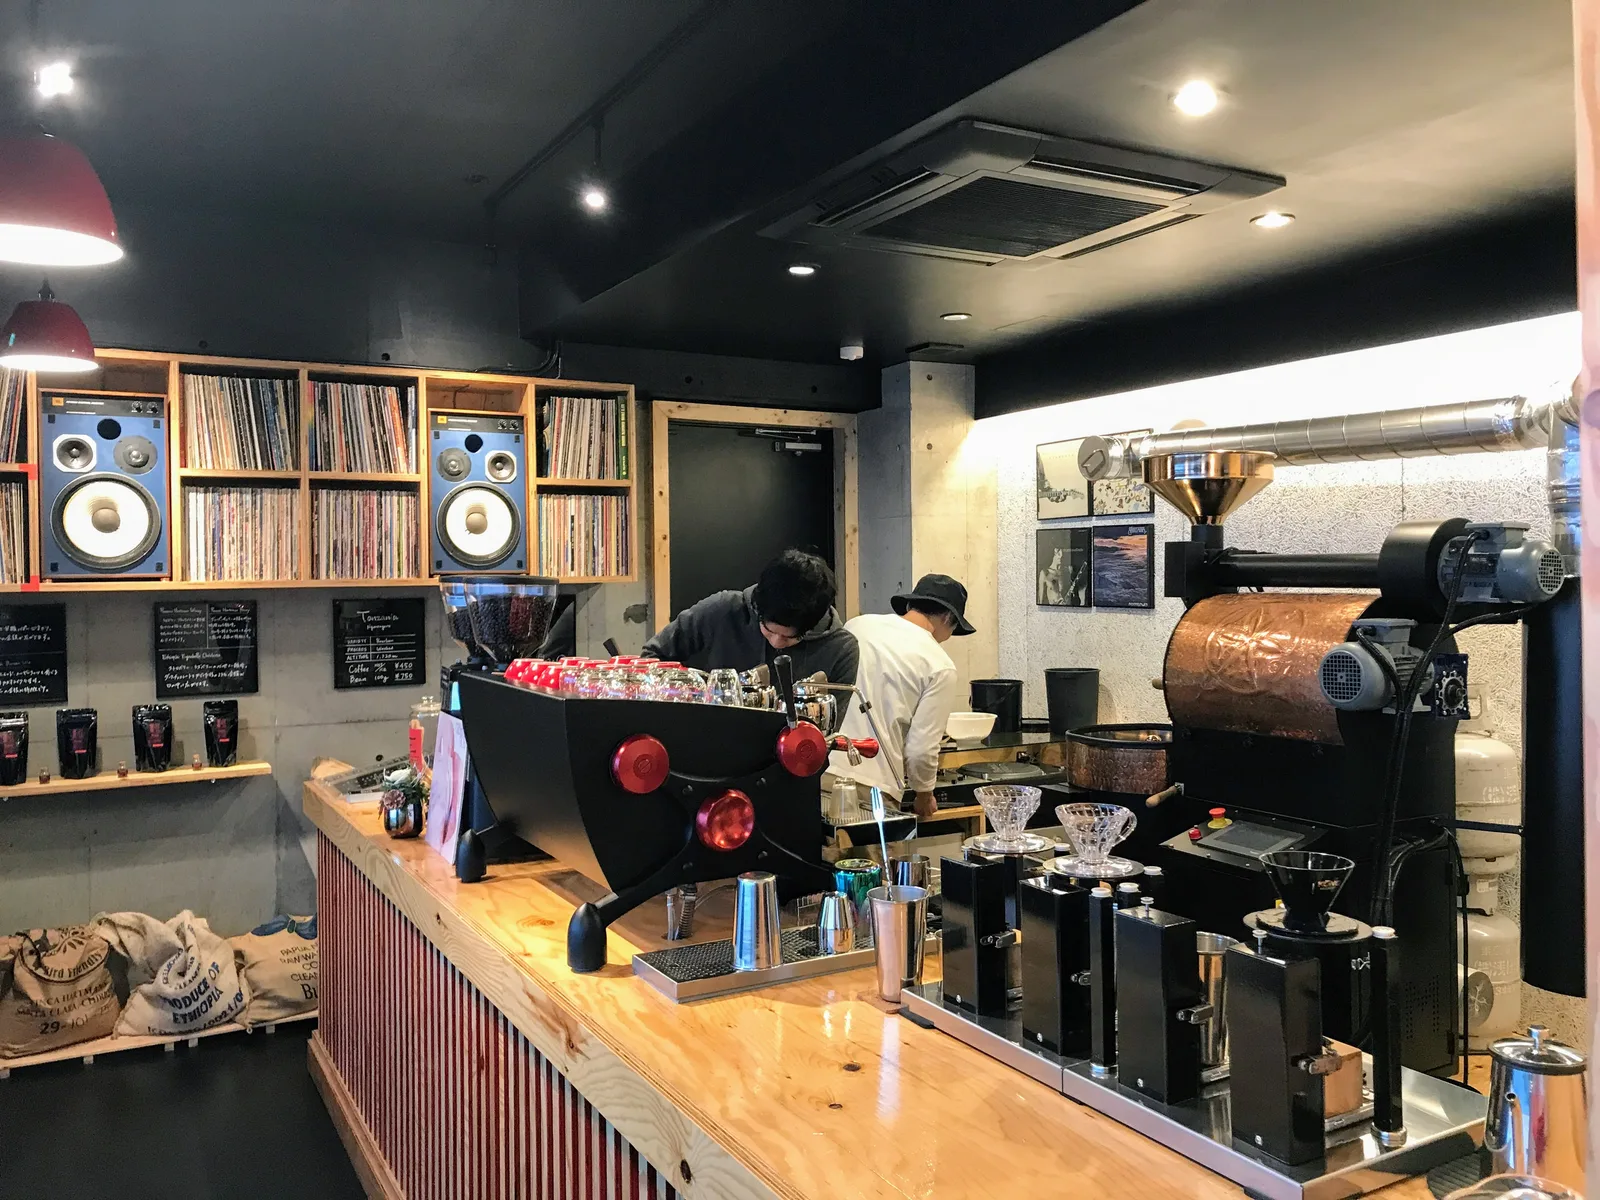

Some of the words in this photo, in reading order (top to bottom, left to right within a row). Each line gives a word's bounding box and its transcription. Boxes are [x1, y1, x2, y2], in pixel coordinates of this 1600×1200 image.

[348, 664, 370, 674] Coffee
[208, 961, 220, 981] OF
[172, 985, 224, 1025] ETHIOPIA
